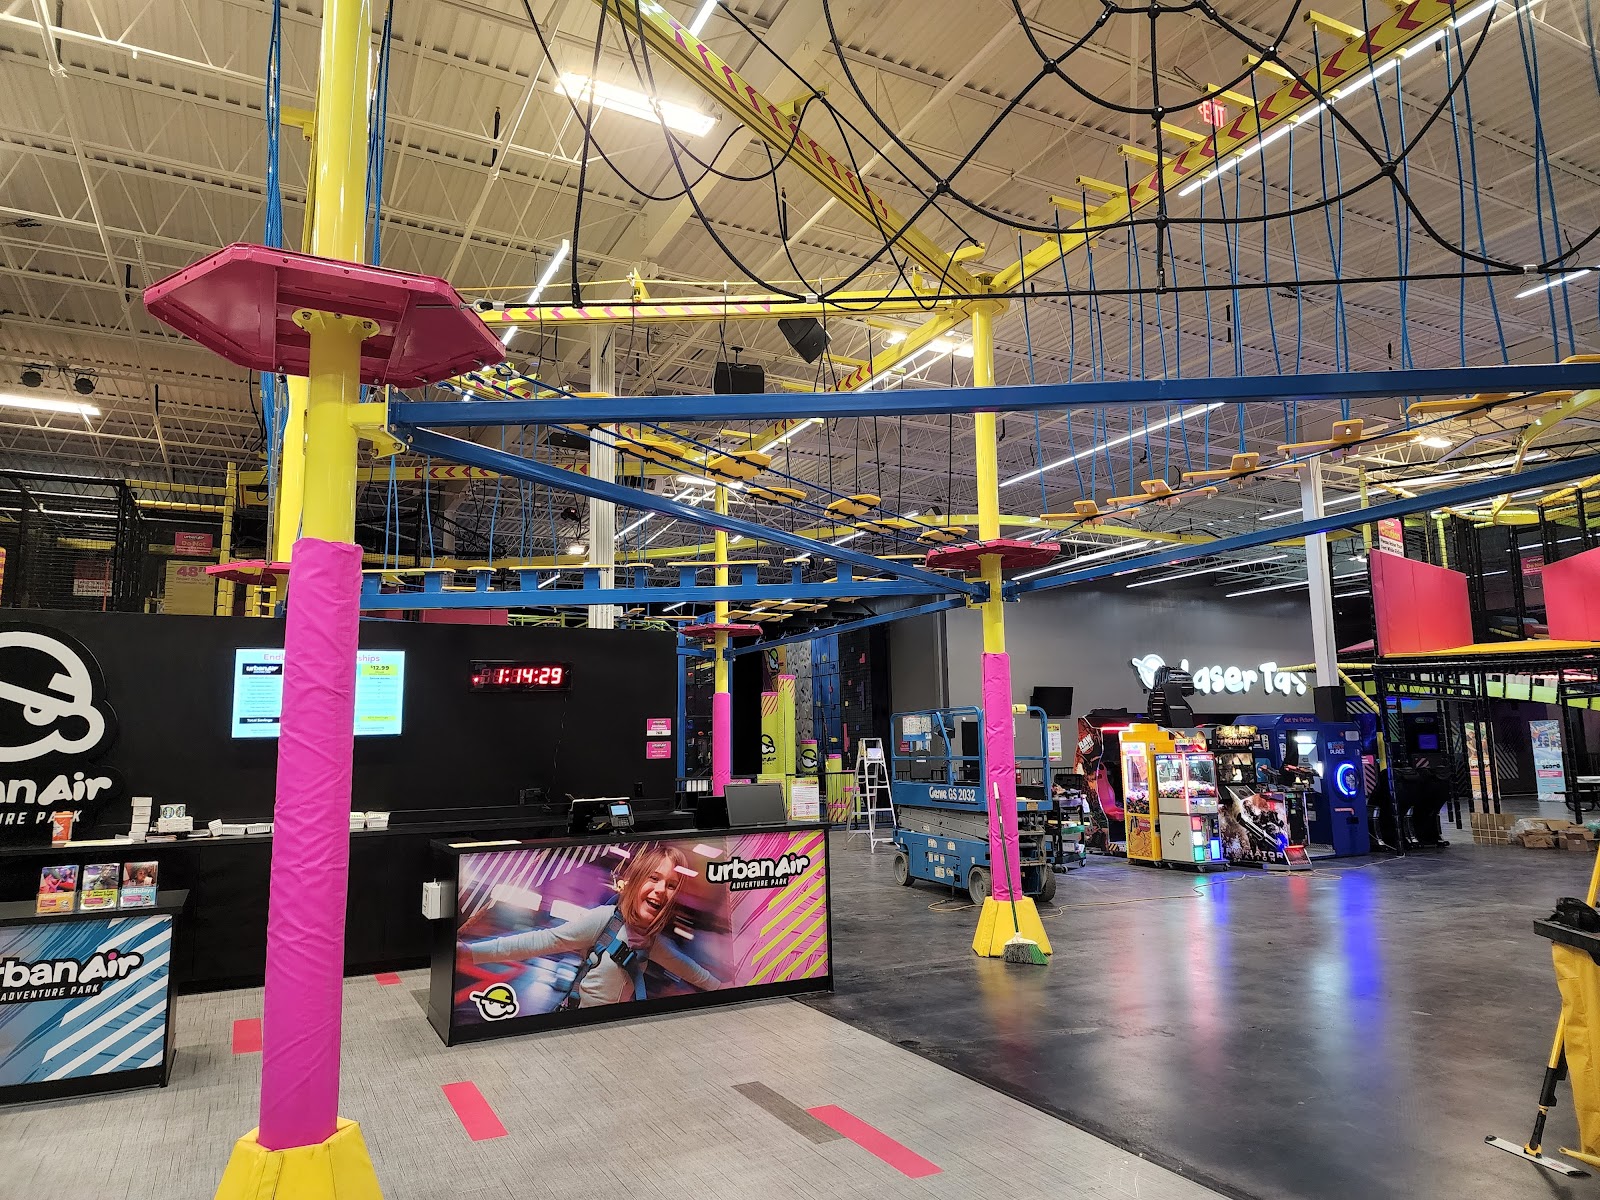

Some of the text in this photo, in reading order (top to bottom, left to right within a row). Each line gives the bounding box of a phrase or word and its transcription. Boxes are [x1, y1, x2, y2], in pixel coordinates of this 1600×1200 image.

[948, 787, 957, 800] GS
[958, 789, 976, 802] 2032
[36, 810, 82, 825] PAK
[731, 877, 787, 889] ADVENTURE PARK
[0, 983, 100, 1001] ADVENTURE PARK
